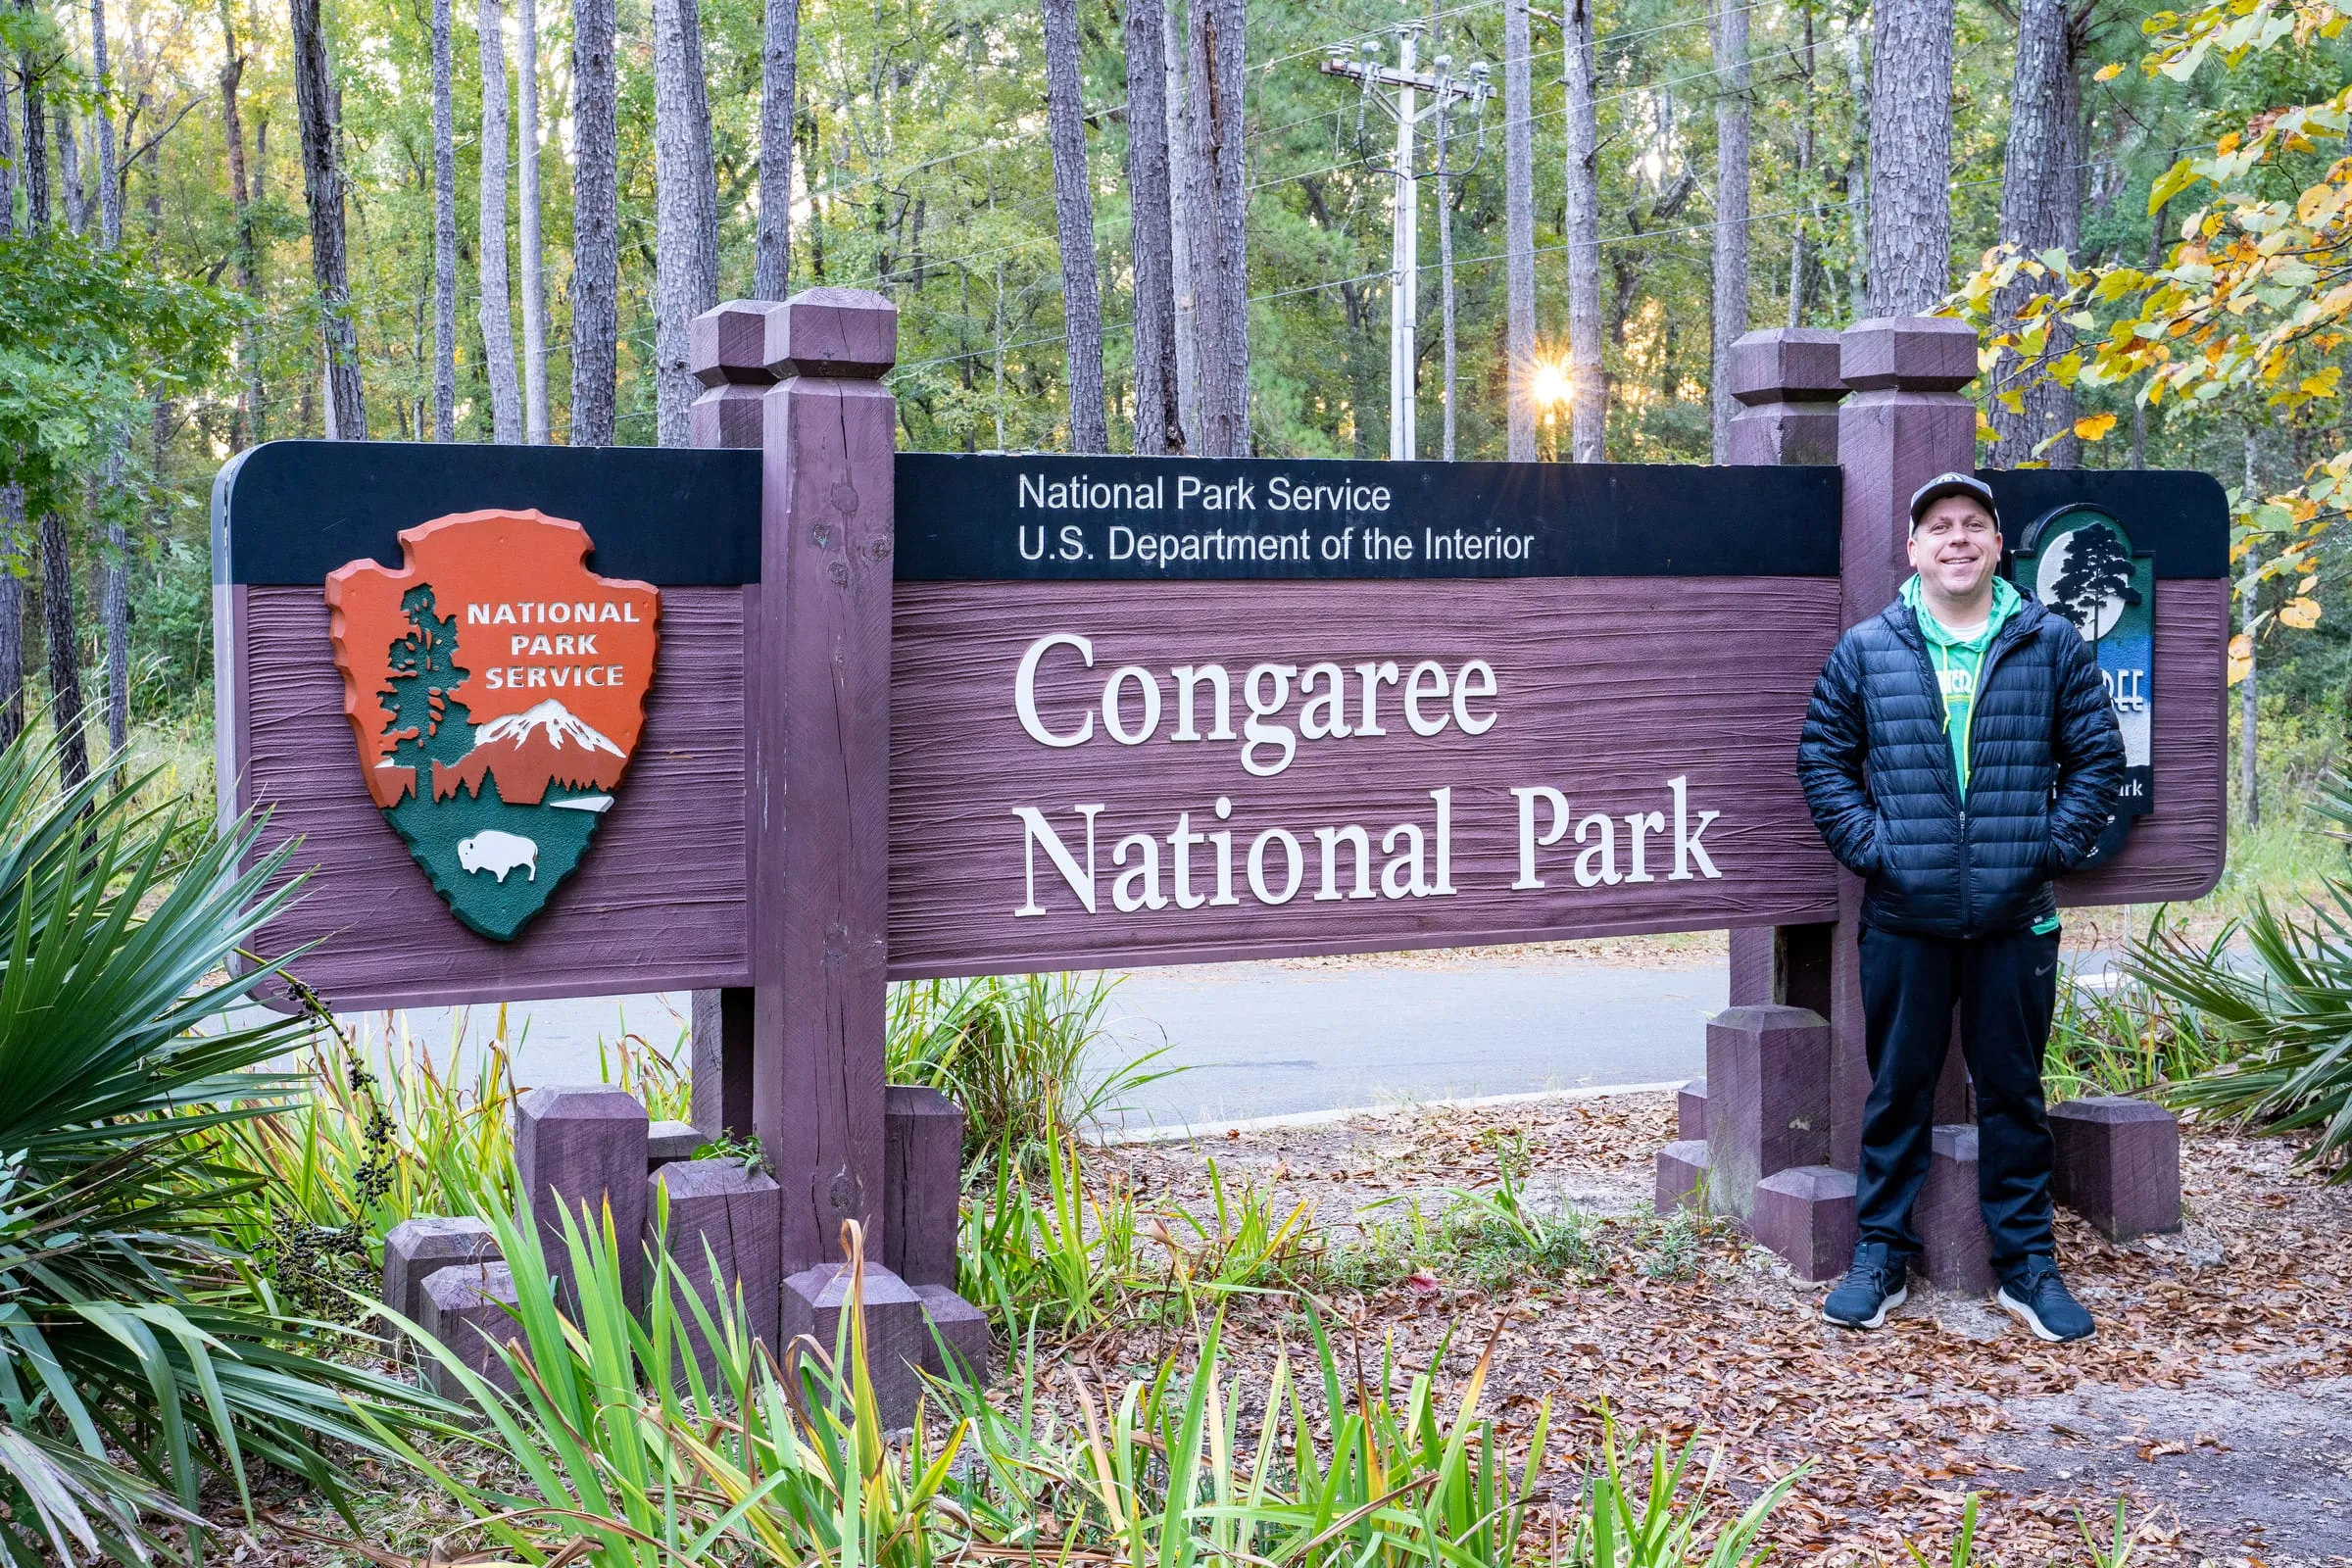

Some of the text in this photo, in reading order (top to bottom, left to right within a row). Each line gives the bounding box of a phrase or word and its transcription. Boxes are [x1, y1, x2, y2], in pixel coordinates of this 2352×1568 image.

[1019, 473, 1391, 512] National Park Service
[1019, 525, 1535, 567] U.S. Department of the Interior
[467, 602, 640, 625] NATIONAL
[511, 634, 599, 656] PARK
[485, 664, 624, 690] SERVICE
[1014, 633, 1497, 776] Congaree
[1011, 774, 1722, 917] National Park
